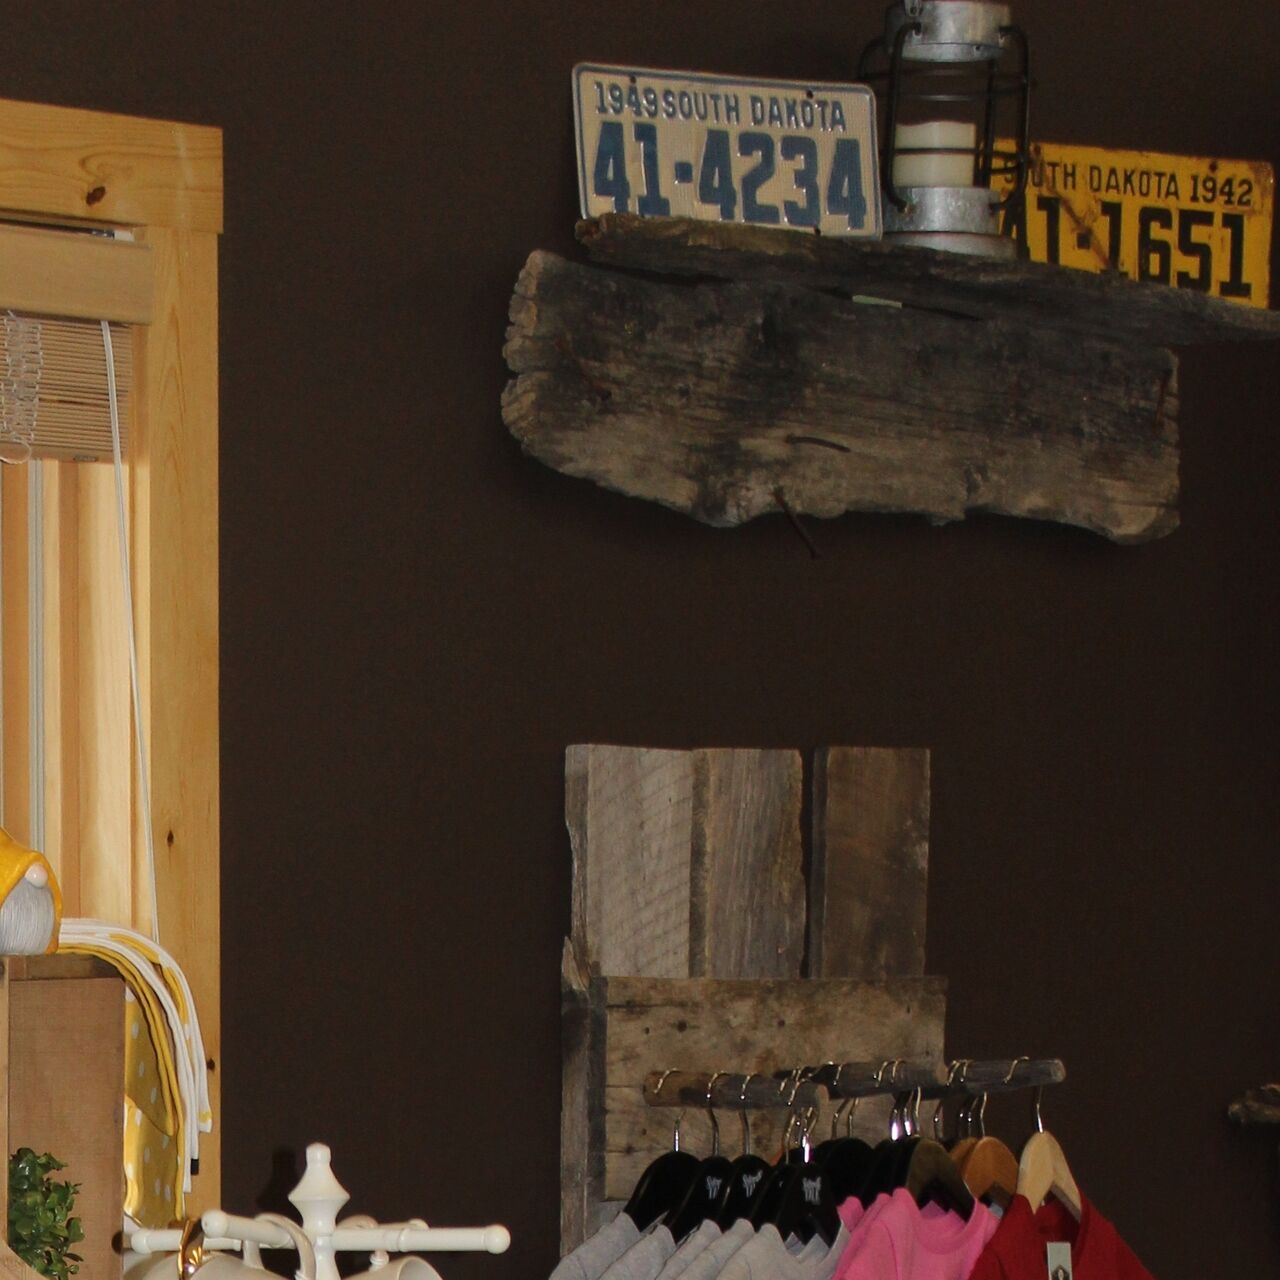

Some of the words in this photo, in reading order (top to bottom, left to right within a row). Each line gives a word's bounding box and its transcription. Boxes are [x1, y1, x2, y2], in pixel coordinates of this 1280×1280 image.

[594, 81, 658, 118] 1949
[662, 88, 741, 125] SOUTH
[750, 95, 847, 133] DAKOTA
[1089, 165, 1180, 200] DAKOTA
[1190, 174, 1253, 206] 1942
